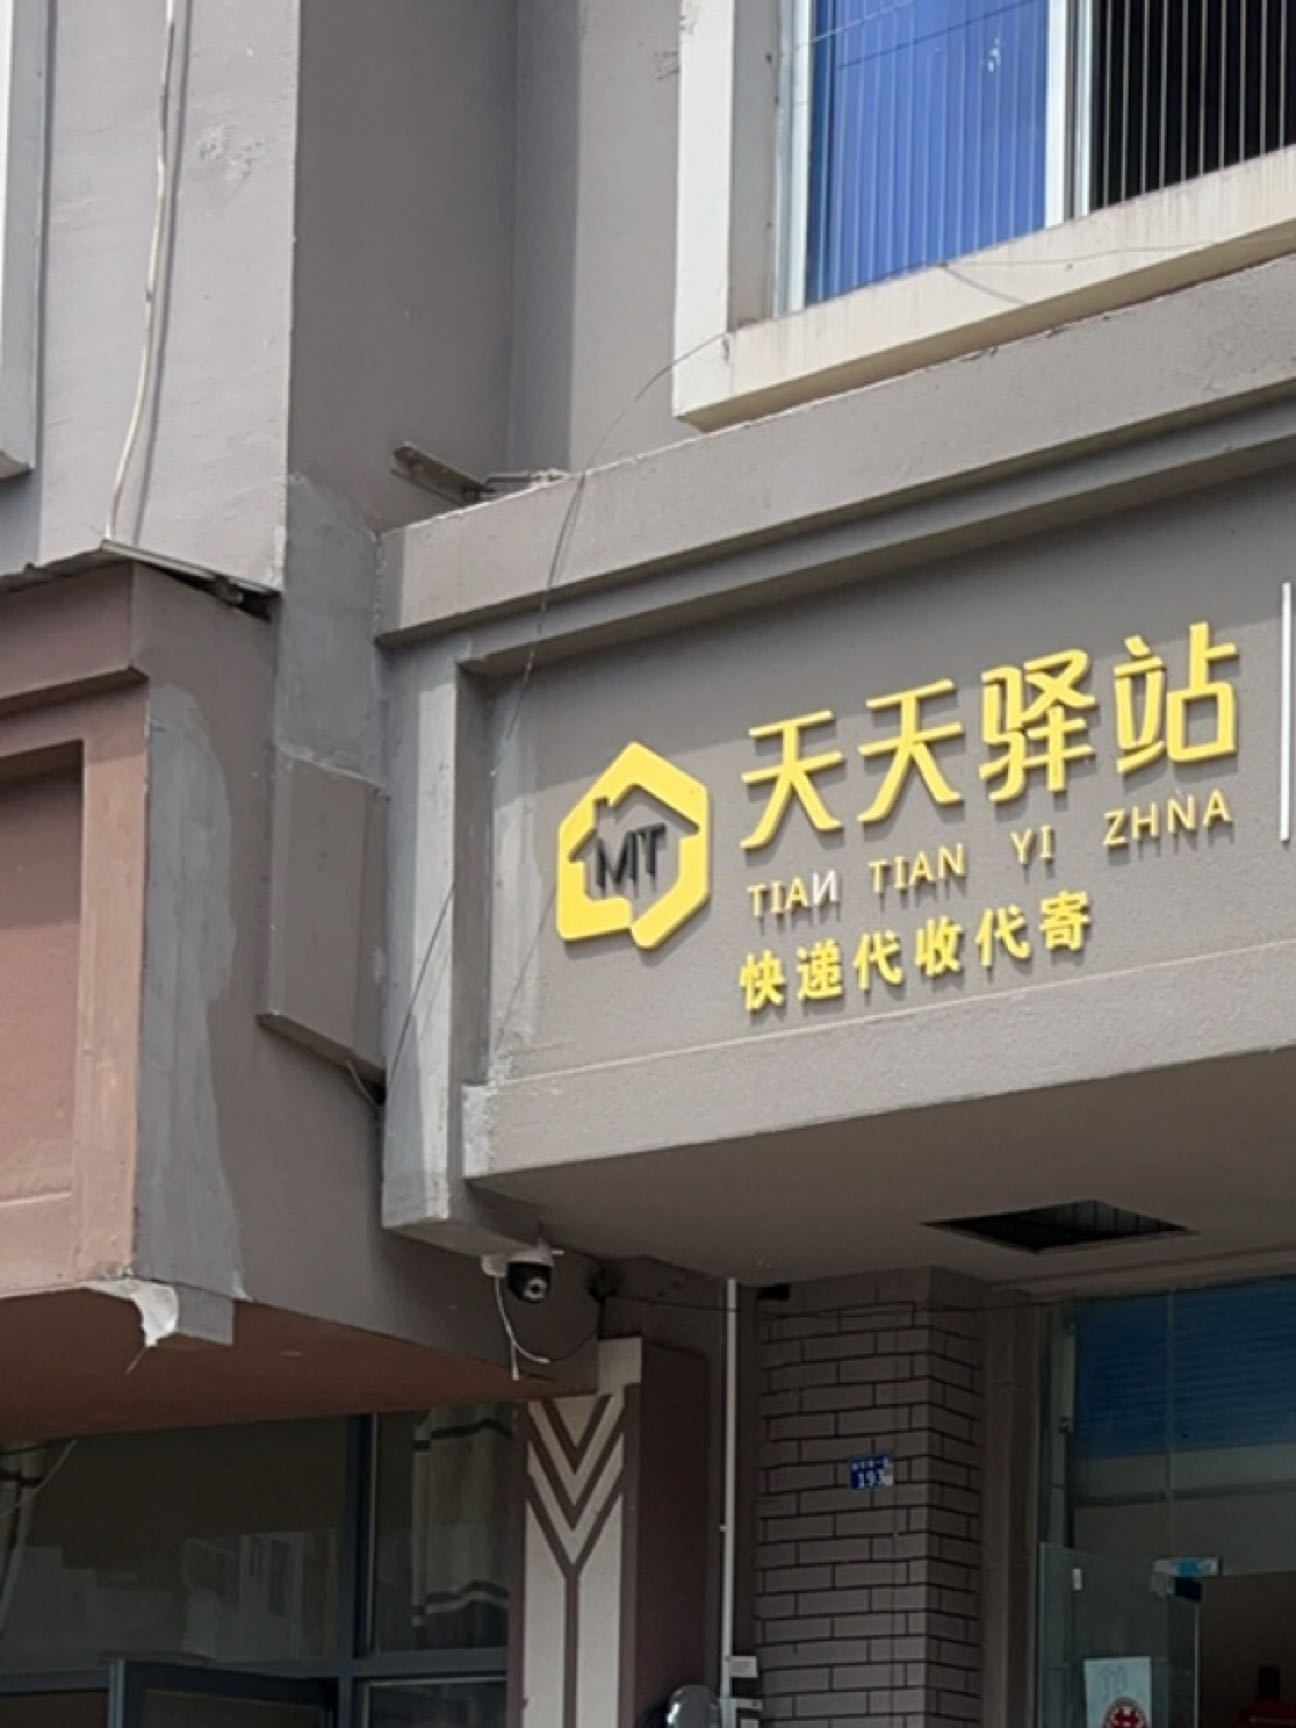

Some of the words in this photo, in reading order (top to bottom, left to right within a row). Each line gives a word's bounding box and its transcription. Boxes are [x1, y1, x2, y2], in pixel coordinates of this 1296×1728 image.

[740, 621, 1239, 850] 天天驿站
[869, 842, 967, 894] TIAN
[1010, 825, 1055, 865] YI
[1103, 789, 1233, 847] ZHNA
[740, 890, 1092, 1011] 快递代收代寄
